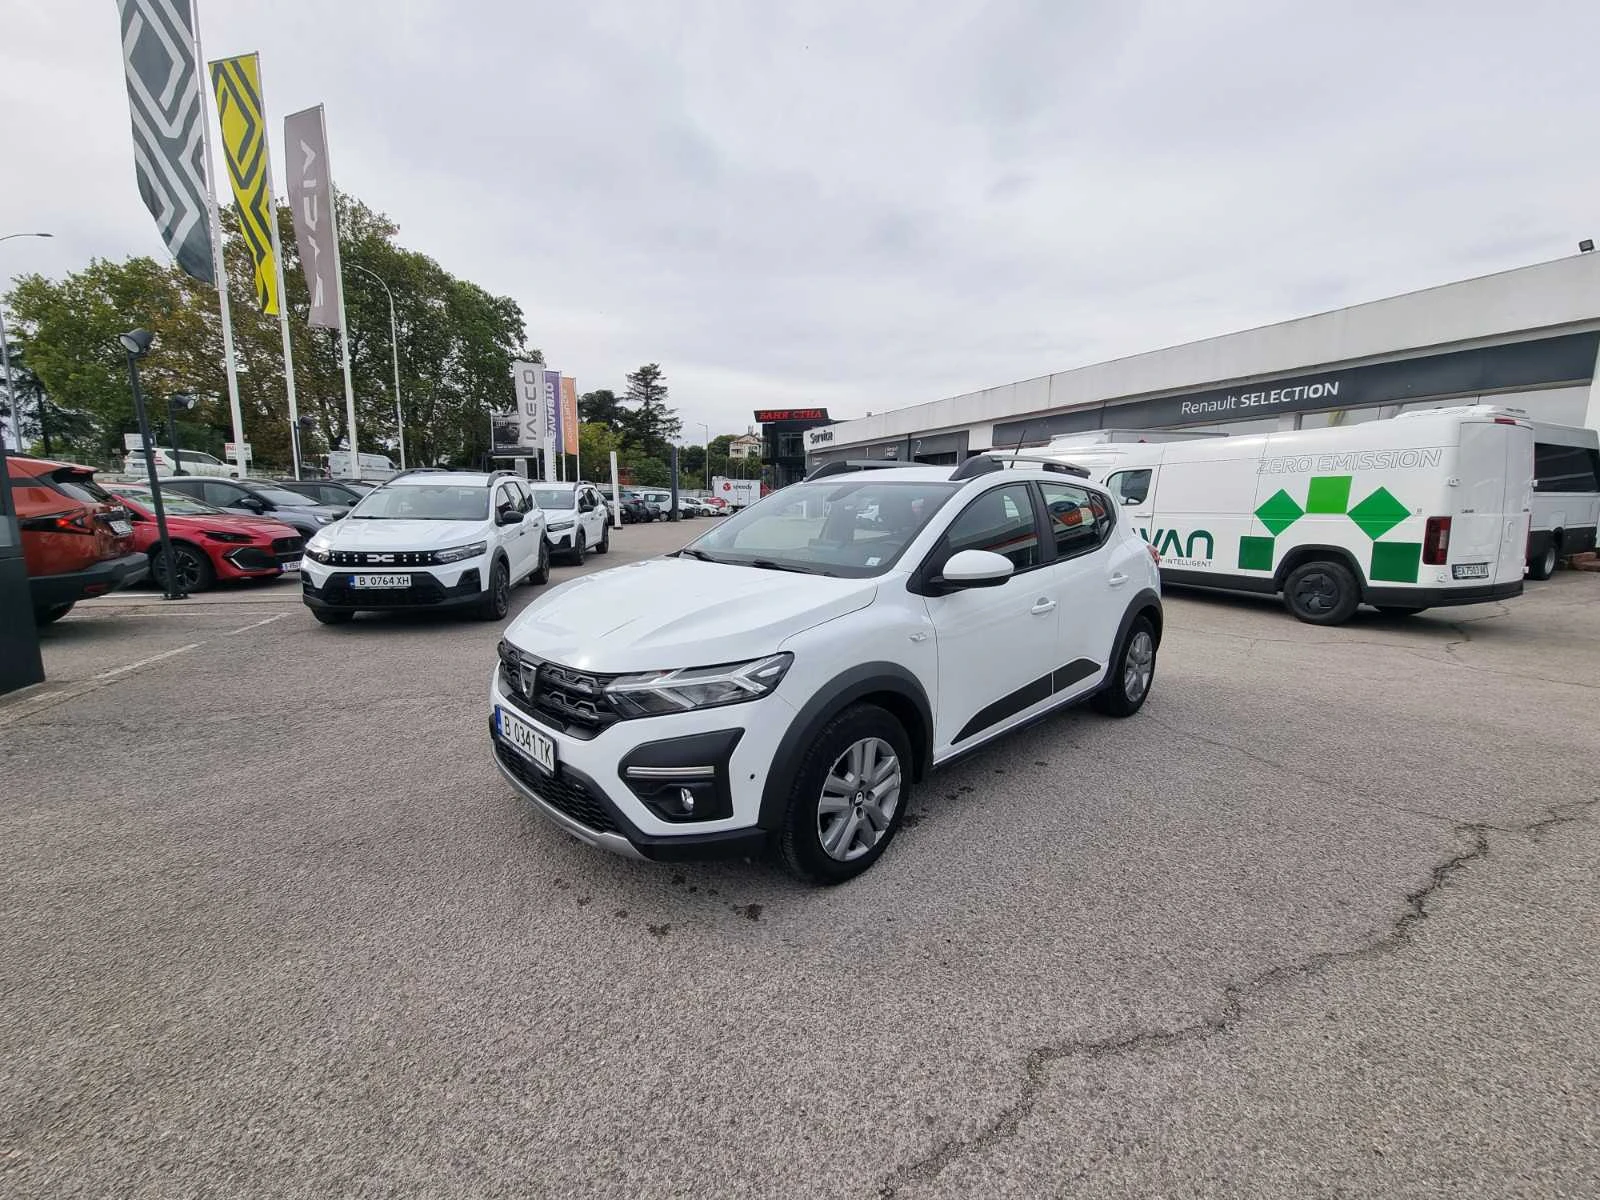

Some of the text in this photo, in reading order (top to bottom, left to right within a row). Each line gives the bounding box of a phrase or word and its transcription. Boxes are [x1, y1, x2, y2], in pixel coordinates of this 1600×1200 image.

[1181, 381, 1339, 415] Renault SELECTION
[1256, 449, 1442, 474] ZERO EMISSION
[1132, 528, 1214, 560] VAN
[1165, 558, 1213, 568] INTELLIGENT
[359, 576, 409, 586] B 0764 XH
[504, 715, 552, 766] B 0341 TK
